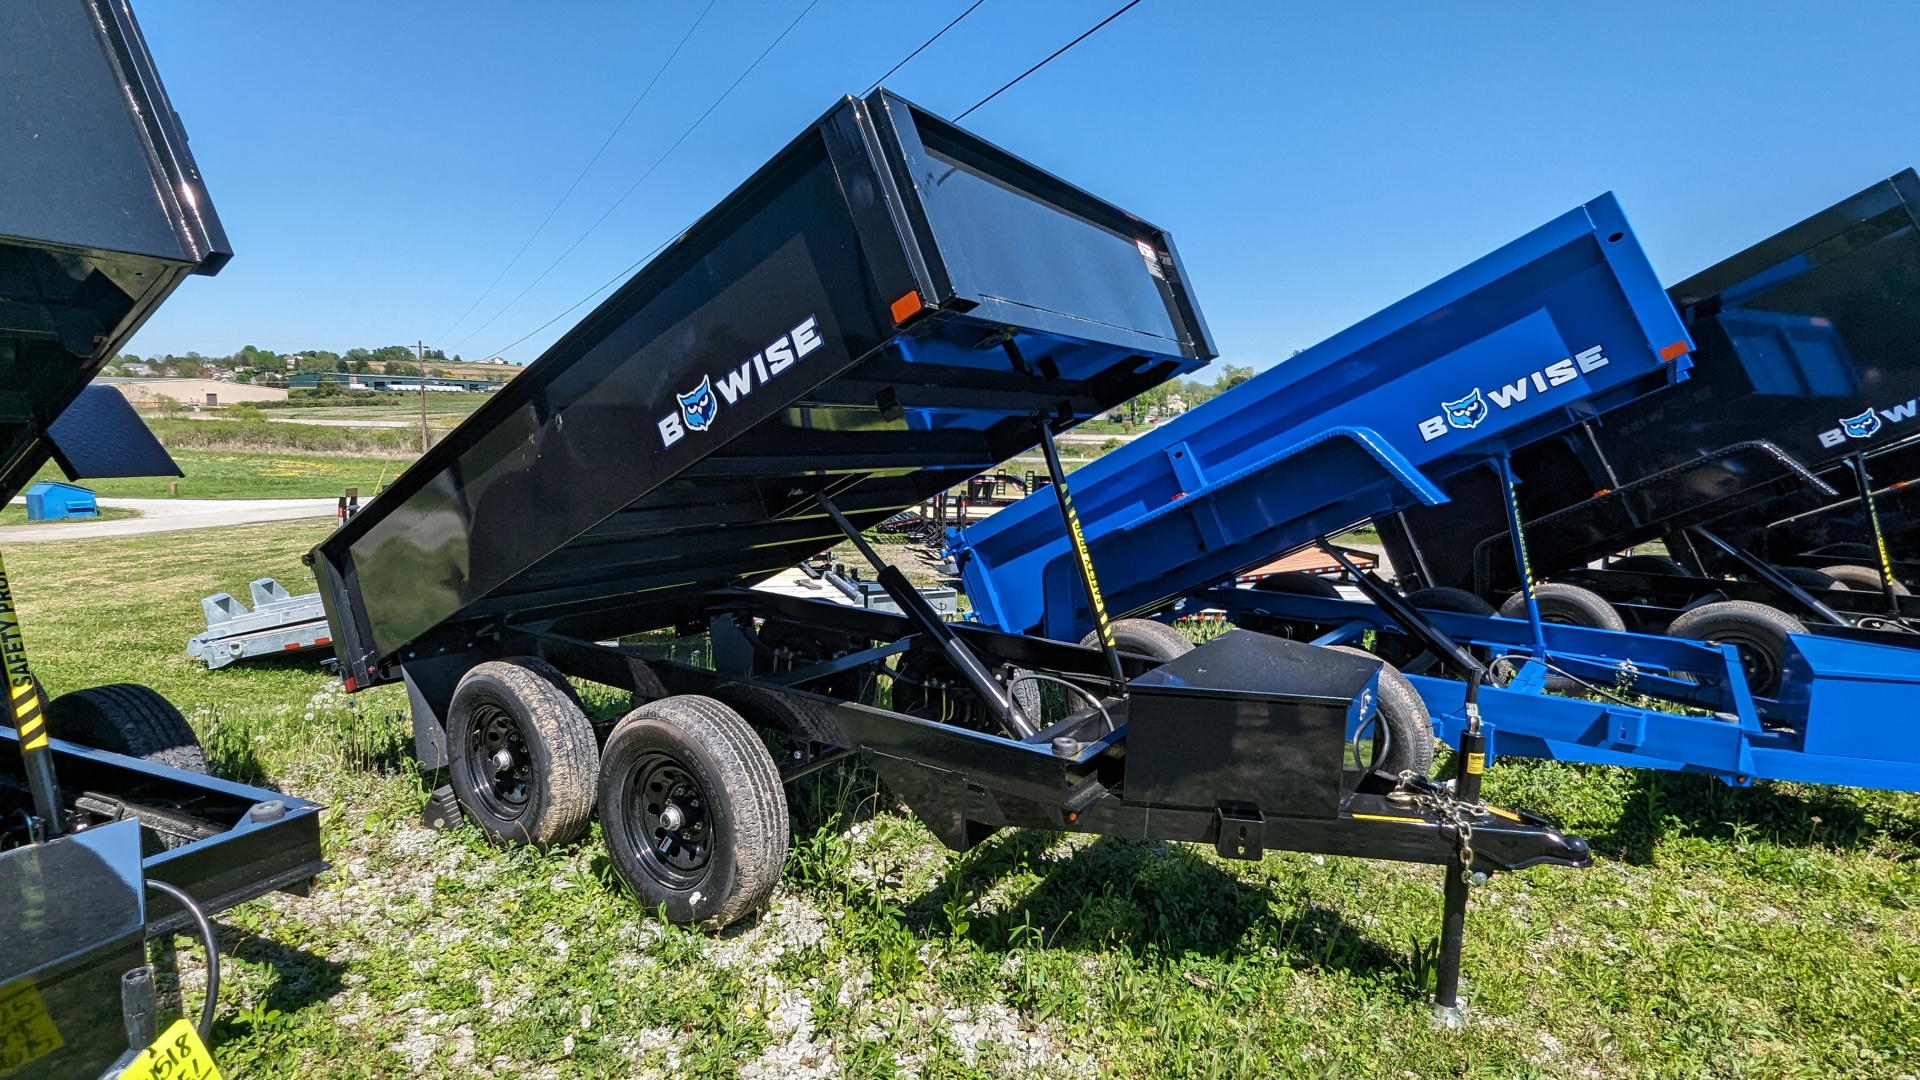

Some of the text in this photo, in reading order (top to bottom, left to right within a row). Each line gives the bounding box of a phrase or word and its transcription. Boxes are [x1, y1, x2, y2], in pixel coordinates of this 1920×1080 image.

[1880, 397, 1920, 423] W
[0, 570, 33, 688] SAFETY PRO
